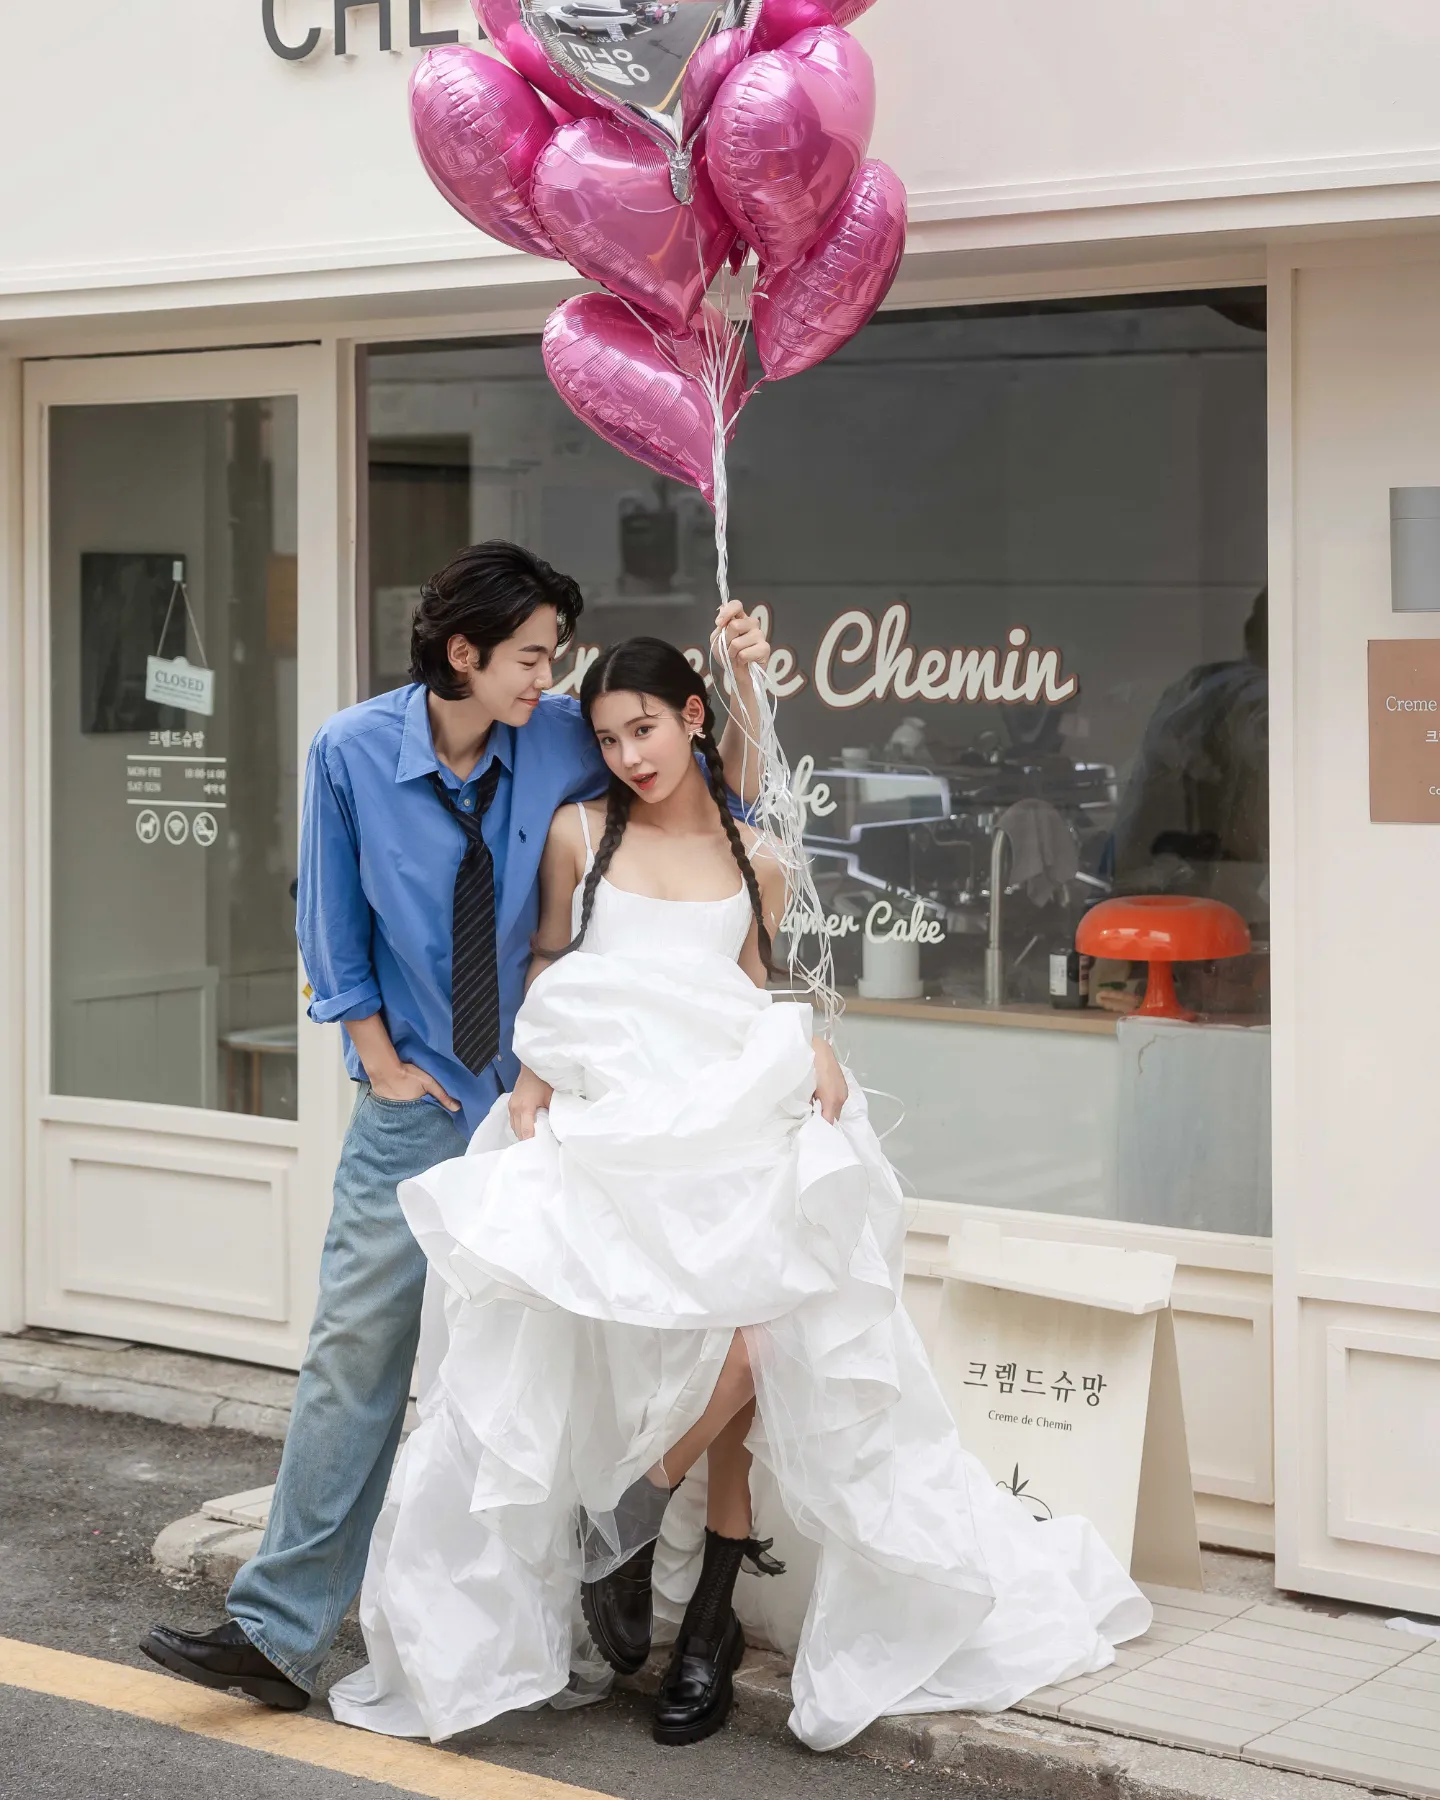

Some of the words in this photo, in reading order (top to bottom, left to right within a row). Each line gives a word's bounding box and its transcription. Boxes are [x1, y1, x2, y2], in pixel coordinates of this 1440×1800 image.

[814, 603, 1077, 709] Chemin
[155, 670, 204, 692] CLOSED
[1386, 695, 1438, 712] Creme
[865, 900, 946, 944] Cake
[963, 1362, 1108, 1407] 크렘드슈망
[988, 1410, 1019, 1425] Creme
[1021, 1414, 1033, 1426] de
[1036, 1416, 1073, 1432] Chemin
